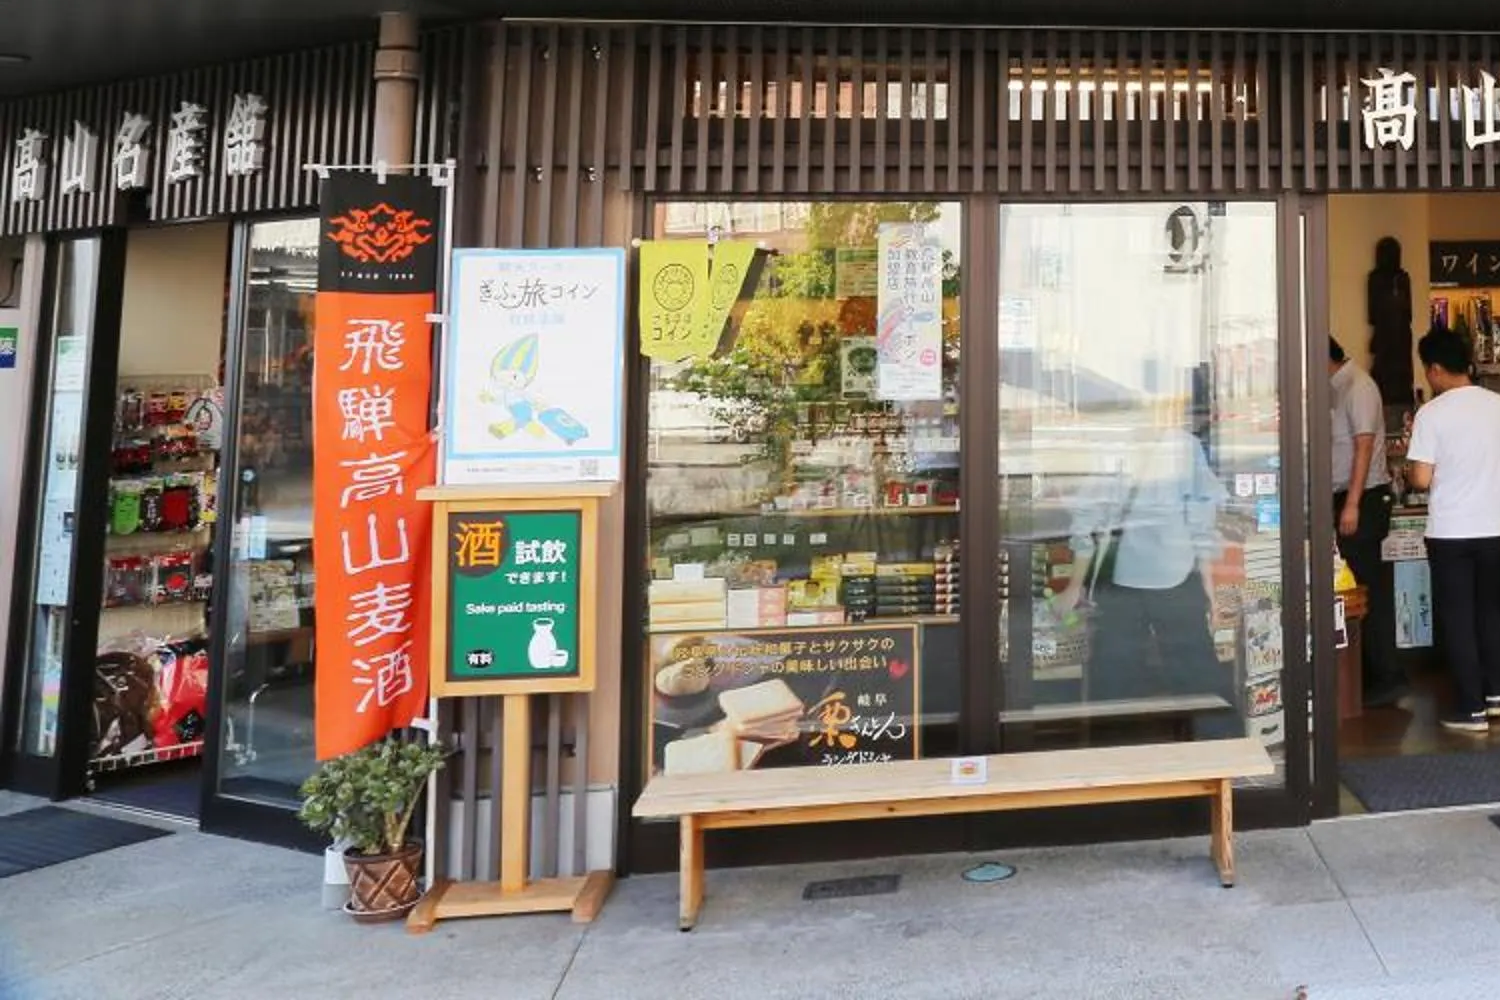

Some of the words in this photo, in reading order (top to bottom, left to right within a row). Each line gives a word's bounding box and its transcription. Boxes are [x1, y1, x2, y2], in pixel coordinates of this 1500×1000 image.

[337, 318, 413, 713] 飛騨高山麦酒
[455, 521, 504, 567] 酒
[515, 539, 567, 565] 試飲
[465, 603, 495, 614] Sake
[497, 602, 523, 615] paid
[525, 601, 565, 614] tasting
